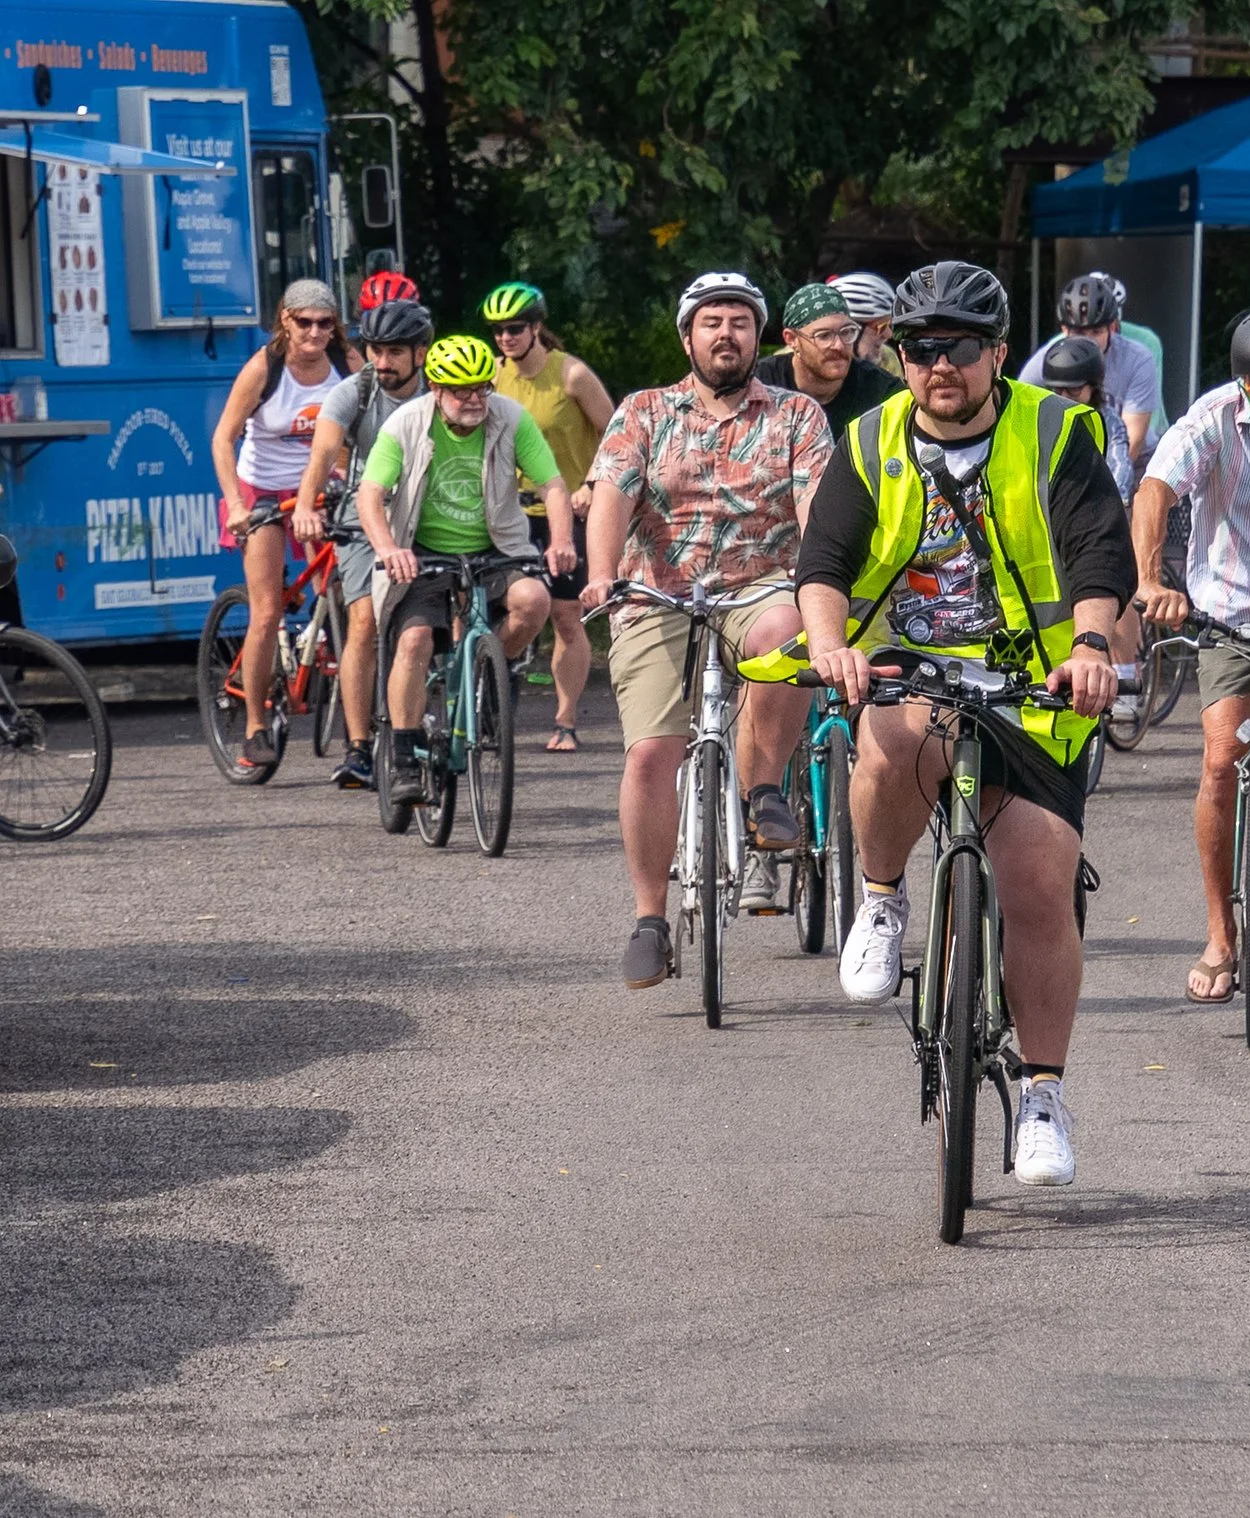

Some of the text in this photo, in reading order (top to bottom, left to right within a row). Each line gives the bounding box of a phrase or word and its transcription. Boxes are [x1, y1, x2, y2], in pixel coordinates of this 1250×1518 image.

[98, 41, 136, 71] Salads
[151, 43, 208, 75] Beverages
[166, 133, 233, 158] Visit us at our
[86, 493, 221, 564] PIZZA KARMA
